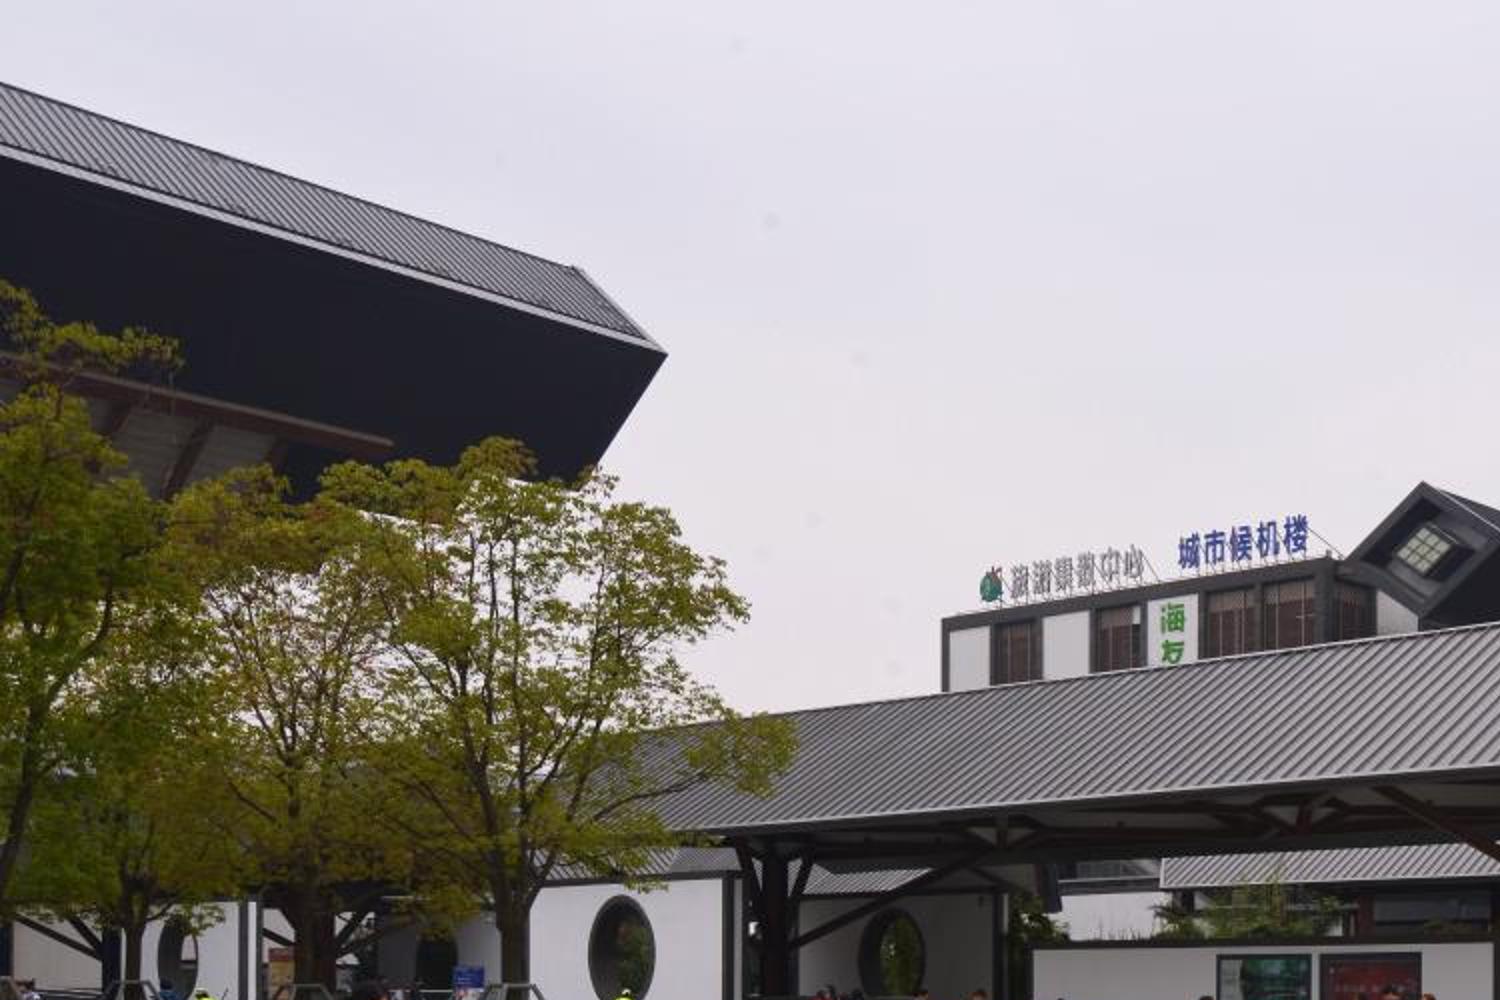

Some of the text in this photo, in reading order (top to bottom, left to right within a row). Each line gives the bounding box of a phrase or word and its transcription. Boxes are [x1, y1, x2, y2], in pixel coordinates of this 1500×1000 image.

[1178, 513, 1308, 569] 城市候机楼
[1160, 602, 1186, 665] 海友
